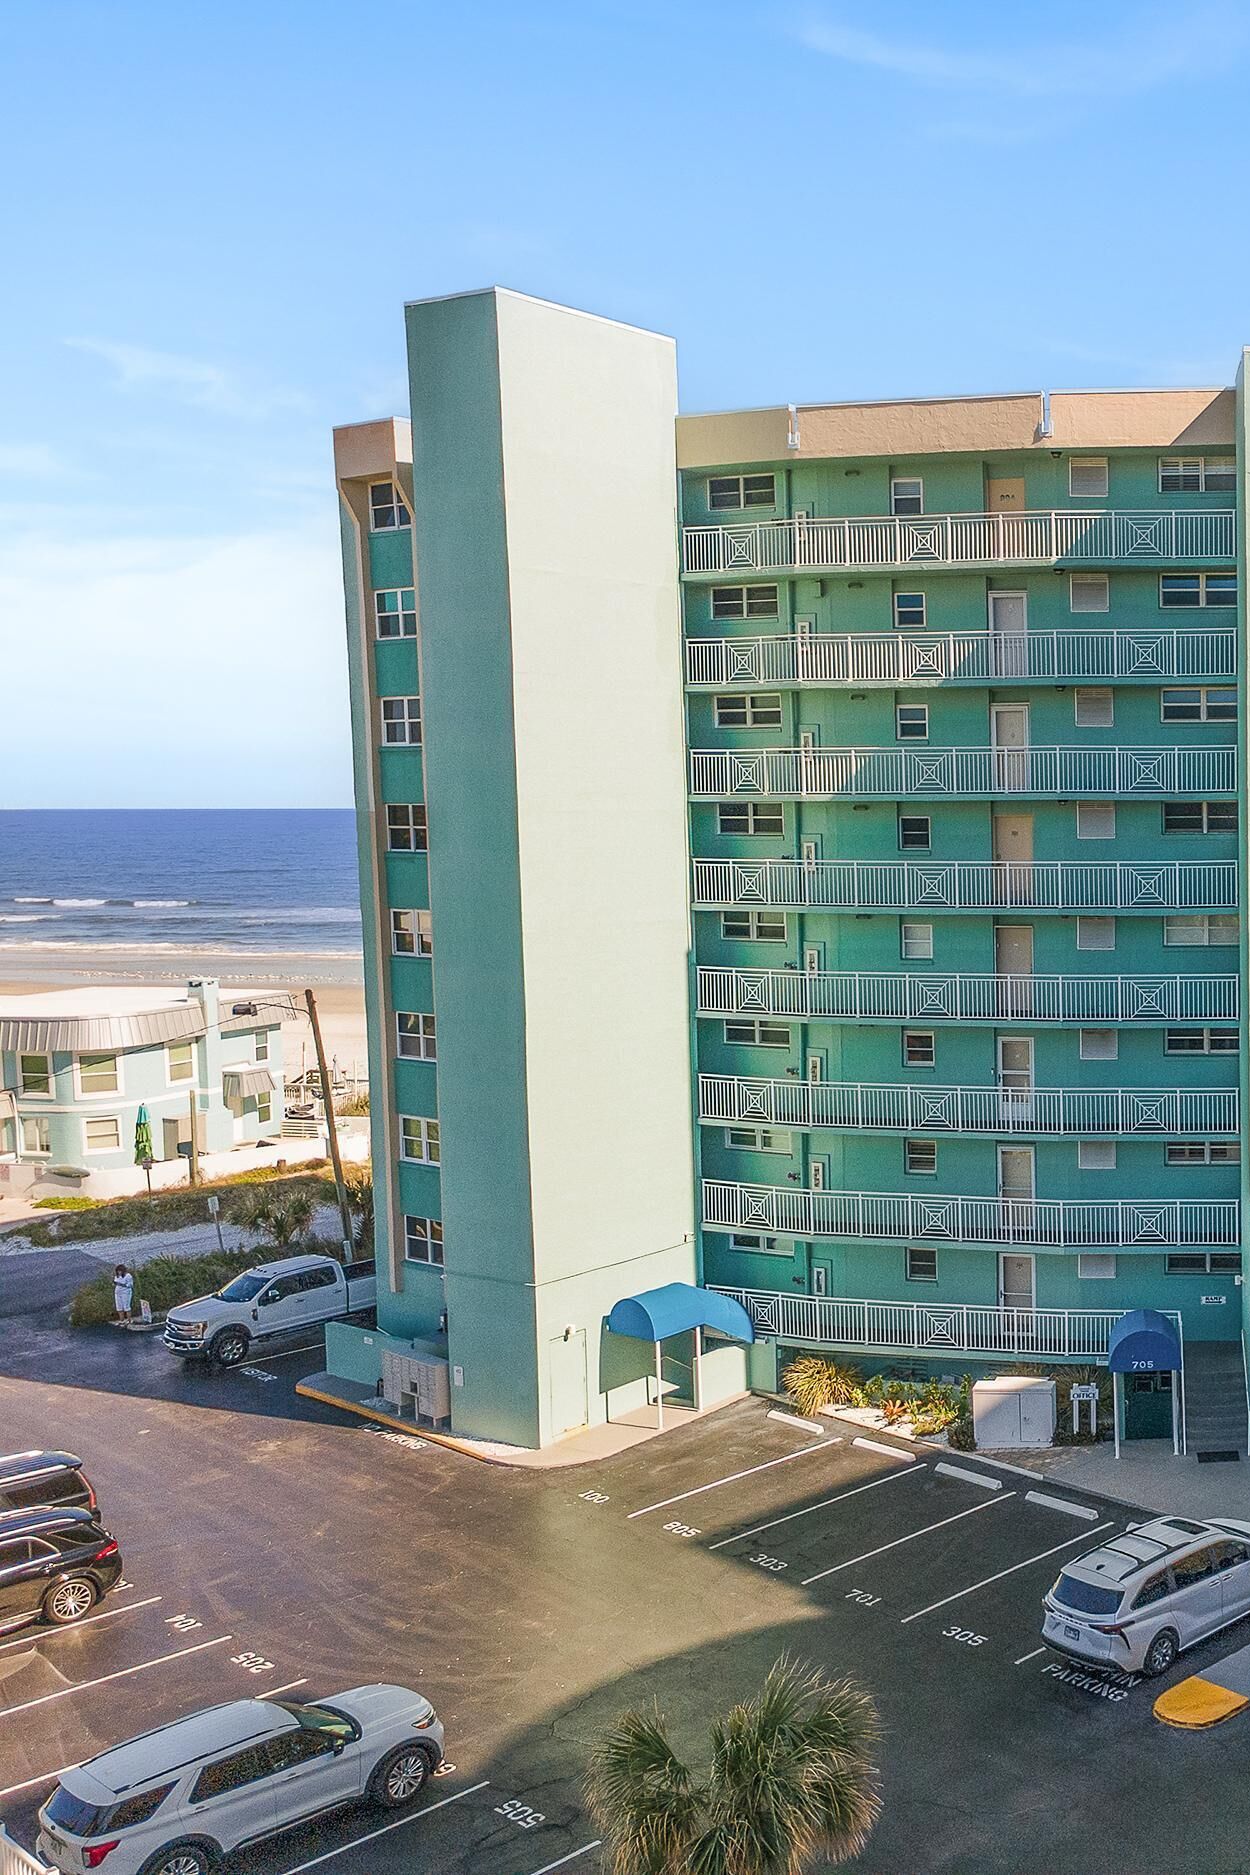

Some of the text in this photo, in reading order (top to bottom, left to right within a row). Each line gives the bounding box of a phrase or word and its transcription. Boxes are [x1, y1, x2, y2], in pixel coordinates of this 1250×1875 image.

[1131, 1360, 1154, 1369] 705
[374, 1429, 428, 1450] PARKING
[578, 1489, 610, 1504] 100
[662, 1521, 701, 1538] 805
[749, 1553, 789, 1571] 303
[844, 1588, 882, 1607] 701
[164, 1613, 203, 1632] 104
[941, 1625, 988, 1646] 305
[230, 1651, 275, 1674] 205
[1041, 1663, 1128, 1702] PARKING
[493, 1799, 546, 1829] 505
